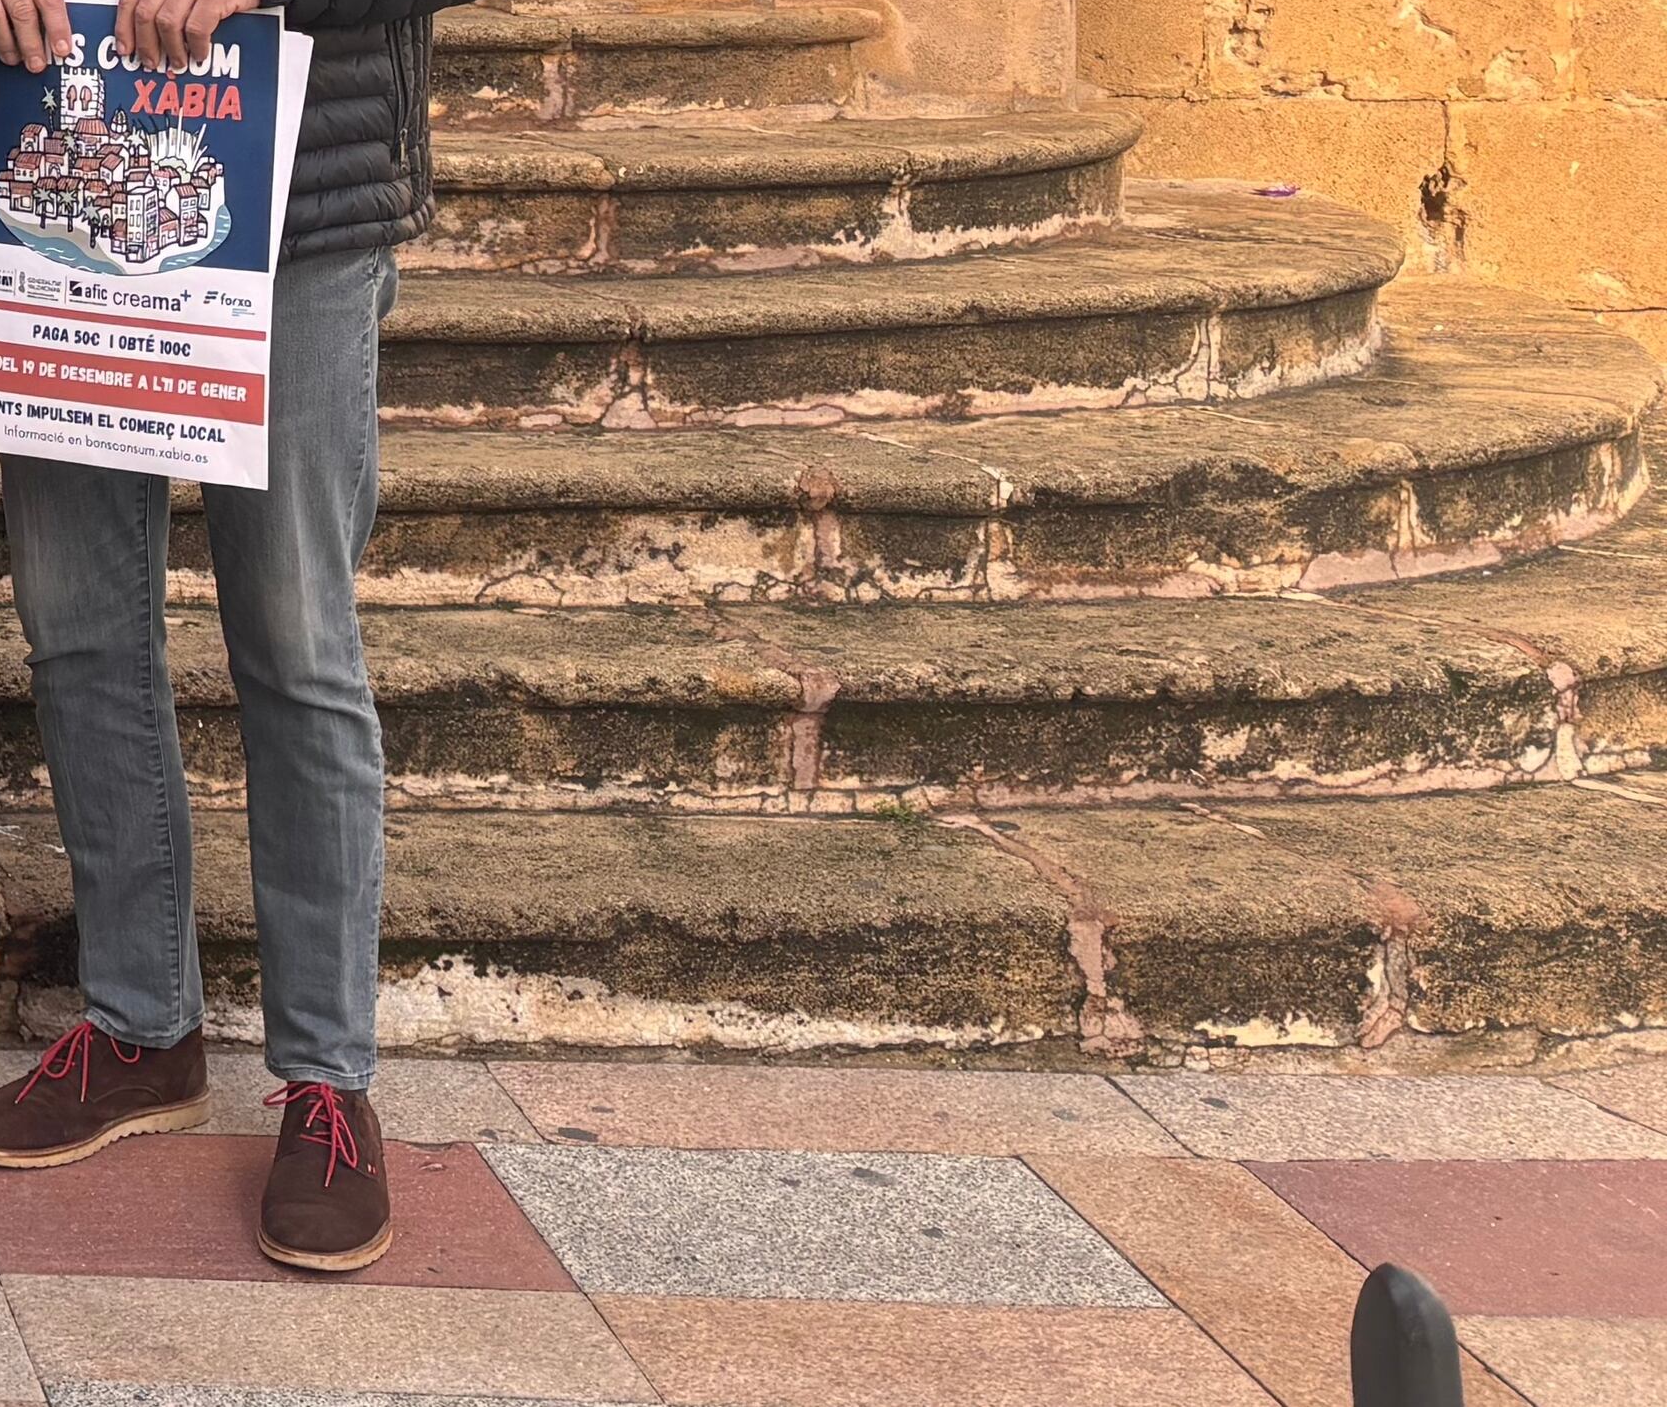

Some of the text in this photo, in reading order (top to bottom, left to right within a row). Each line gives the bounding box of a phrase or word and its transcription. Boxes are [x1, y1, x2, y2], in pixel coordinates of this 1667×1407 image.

[130, 70, 242, 121] XÀBIA
[84, 283, 108, 301] afic
[220, 293, 252, 308] forxa
[32, 324, 68, 343] PAGA
[118, 334, 155, 353] OBTÉ
[160, 340, 191, 357] 100€
[22, 359, 35, 375] 19
[38, 363, 57, 378] DE
[60, 365, 133, 388] DESEMBRE
[137, 374, 148, 390] A
[177, 380, 197, 395] DE
[200, 384, 247, 402] GENER
[4, 425, 64, 444] Informació
[68, 435, 82, 446] en
[27, 406, 93, 426] IMPULSEM
[98, 413, 114, 429] EL
[119, 417, 175, 440] COMERÇ
[180, 423, 226, 443] LOCAL
